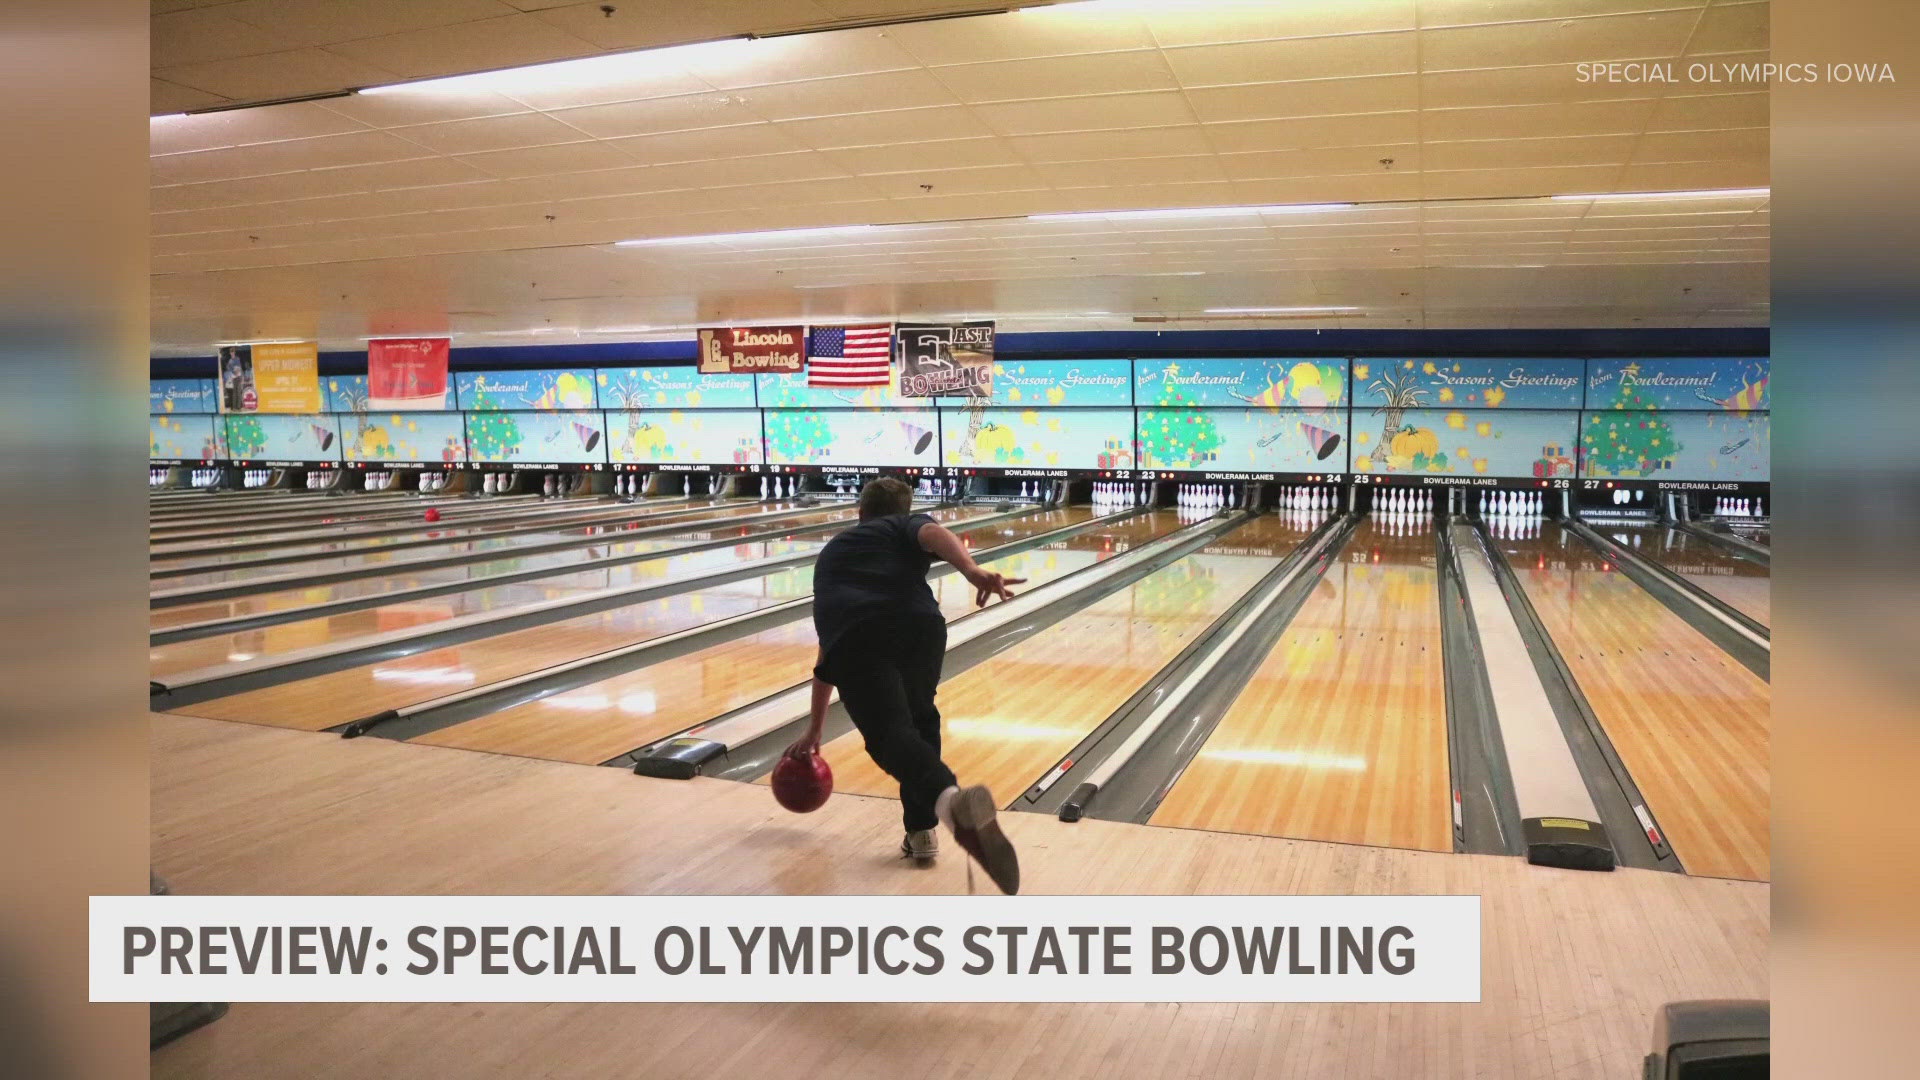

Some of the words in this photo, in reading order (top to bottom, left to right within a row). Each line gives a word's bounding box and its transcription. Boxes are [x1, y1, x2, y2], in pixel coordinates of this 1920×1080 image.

[733, 329, 793, 346] Lincoln
[733, 351, 800, 369] Bowling
[900, 365, 991, 396] BOWLING
[1000, 369, 1055, 386] Season's
[1059, 368, 1127, 388] Greetings
[1138, 373, 1157, 388] from
[1161, 369, 1246, 385] Bowlerama!
[1430, 367, 1495, 386] Season's
[1500, 367, 1579, 390] Greetings
[1590, 373, 1613, 389] from
[1618, 369, 1717, 386] Bowlerama!
[922, 467, 935, 476] 20
[1116, 470, 1130, 479] 22
[1142, 471, 1155, 480] 23
[1327, 474, 1341, 483] 24
[1354, 475, 1369, 483] 25
[1554, 480, 1570, 488] 26
[1584, 480, 1599, 489] 27
